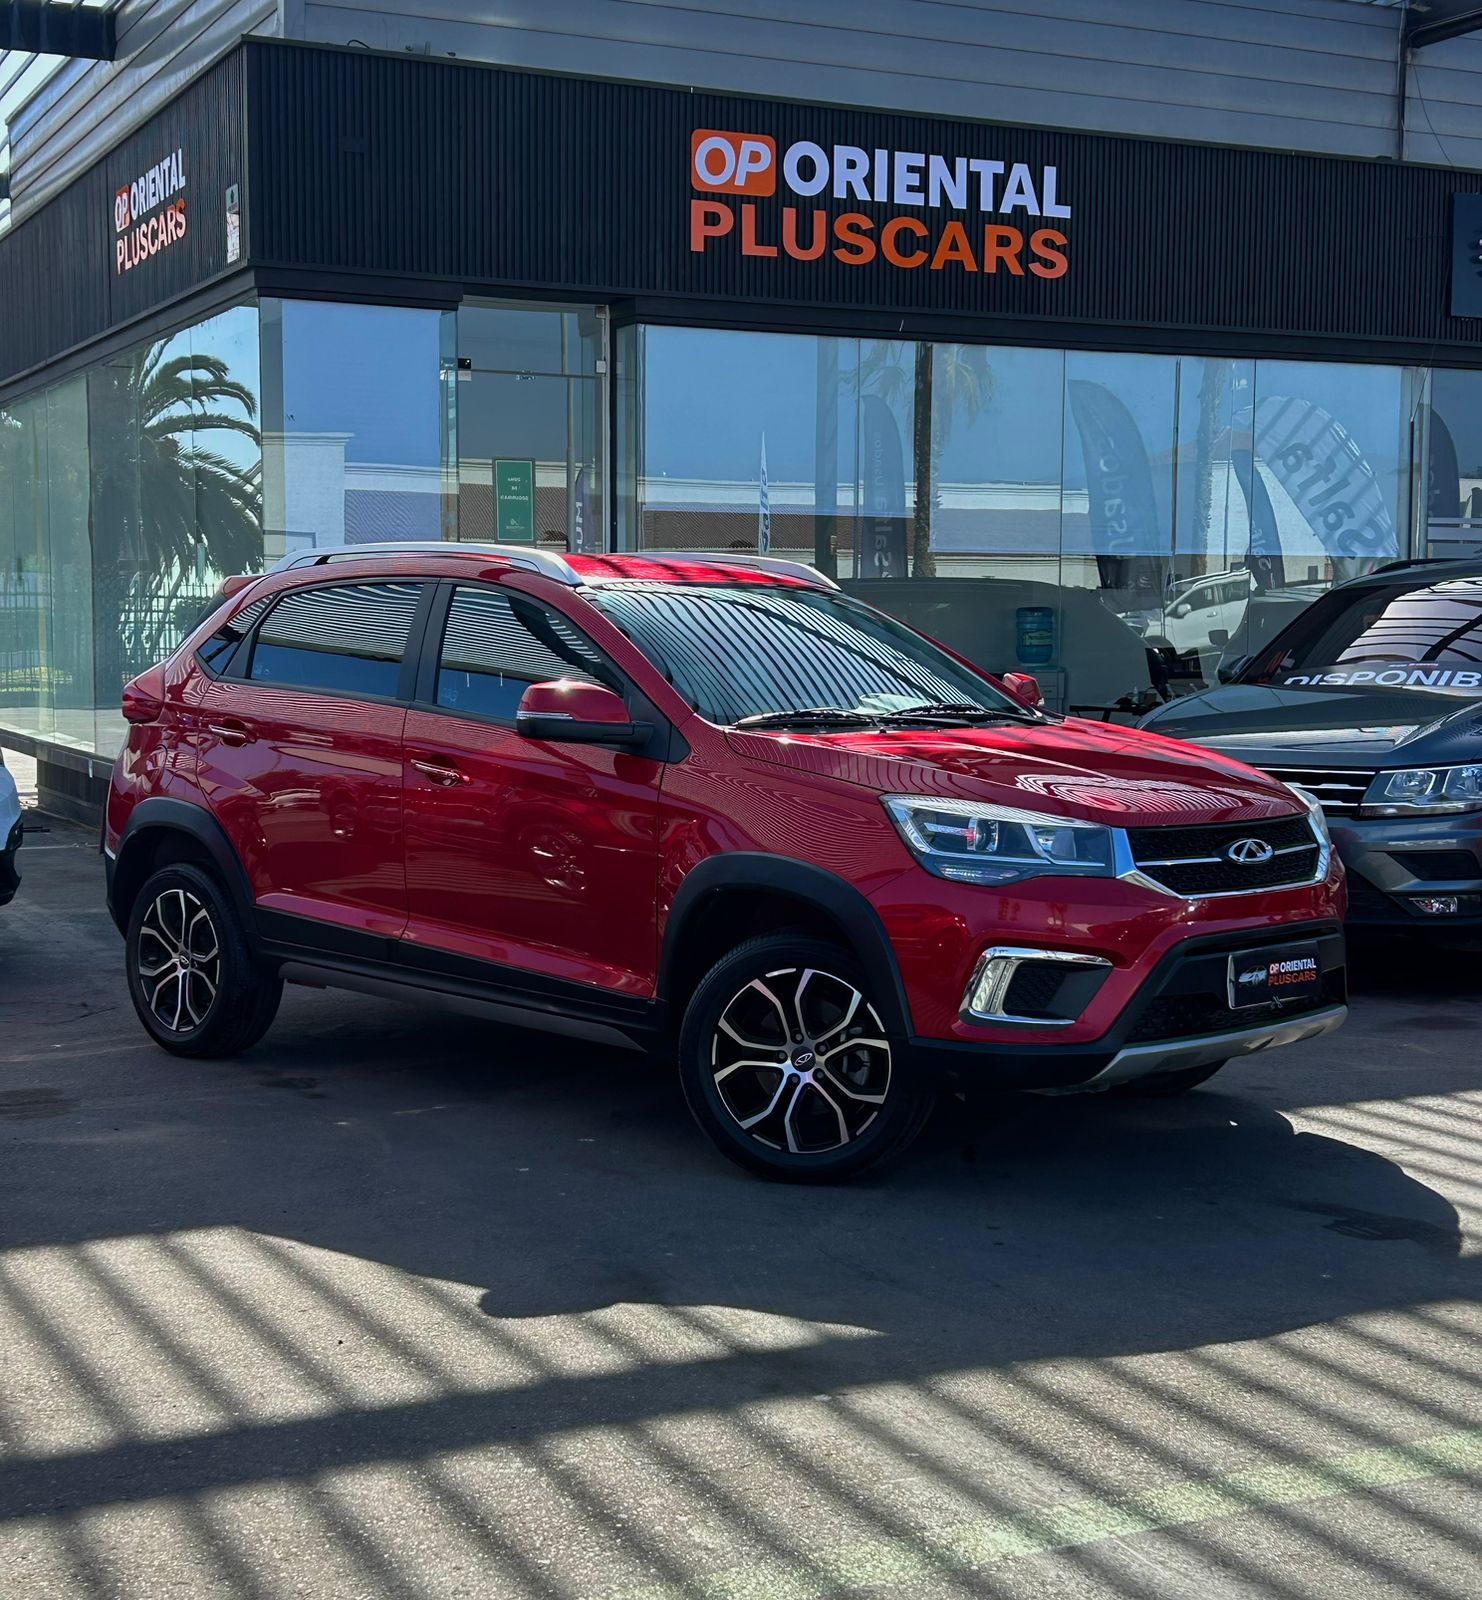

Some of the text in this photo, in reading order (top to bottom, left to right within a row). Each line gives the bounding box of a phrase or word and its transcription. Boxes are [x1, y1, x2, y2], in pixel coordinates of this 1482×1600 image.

[114, 148, 186, 229] OP ORIENTAL
[694, 135, 1072, 219] OP ORIENTAL
[116, 198, 187, 275] PLUSCARS
[690, 199, 1069, 279] PLUSCARS
[1268, 970, 1317, 987] PLUSCARS
[1280, 958, 1317, 973] ORIENTAL
